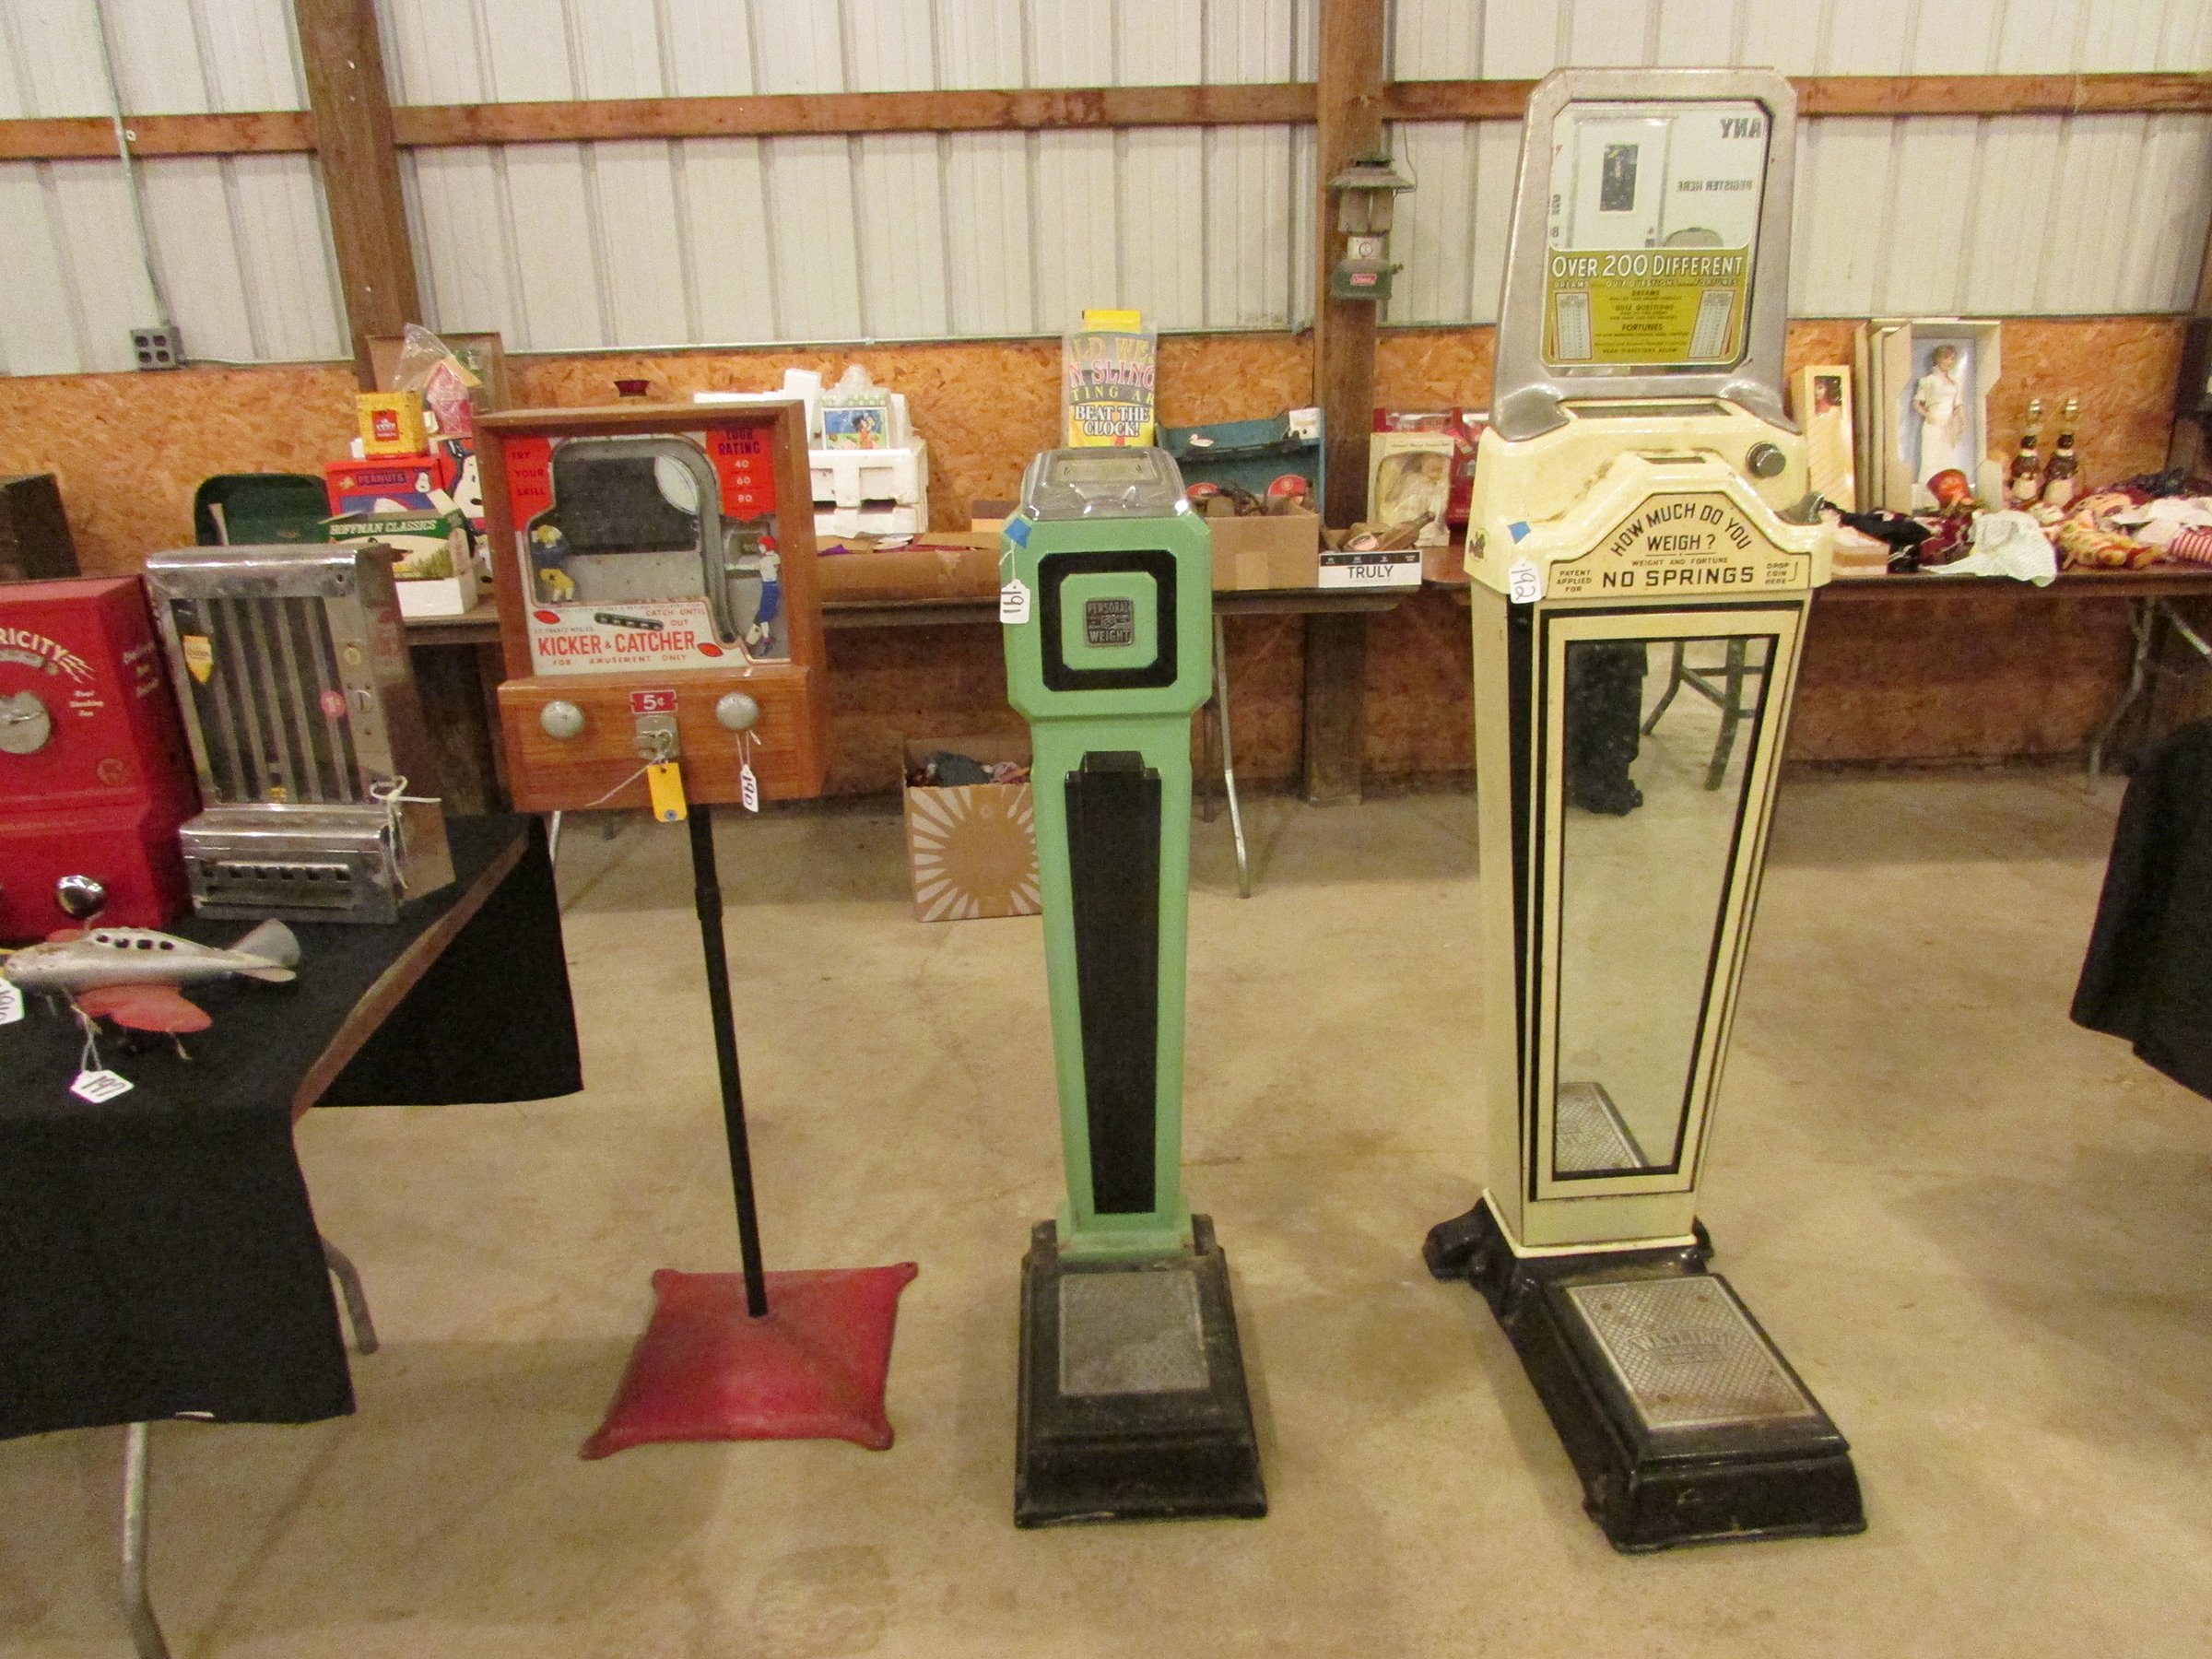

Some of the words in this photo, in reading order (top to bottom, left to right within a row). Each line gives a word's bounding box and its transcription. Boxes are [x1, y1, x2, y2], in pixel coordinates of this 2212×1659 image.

[1552, 256, 1597, 276] OVER
[1603, 254, 1648, 276] 200
[1653, 255, 1743, 276] DIFFERENT
[1622, 324, 1663, 332] FORTUNES
[1070, 336, 1104, 362] LD
[1114, 336, 1155, 362] WE
[1071, 385, 1118, 401] TING
[1076, 406, 1113, 421] BEAT
[1118, 406, 1150, 422] THE
[1084, 420, 1140, 437] CLOCK!
[512, 451, 530, 459] TRY
[718, 441, 760, 455] RATING
[735, 459, 749, 468] 40
[358, 473, 406, 486] PEANUTS
[514, 469, 545, 477] YOUR
[736, 477, 751, 485] 60
[516, 487, 546, 497] SKILL
[737, 494, 753, 502] 80
[330, 523, 382, 535] HOFFMAN
[385, 520, 437, 533] CLASSICS
[1610, 519, 1644, 556] HOW
[1646, 503, 1696, 527] MUCH
[1700, 505, 1724, 525] DO
[1724, 518, 1752, 550] YOU
[1647, 534, 1700, 551] WEIGH
[1690, 557, 1728, 565] FORTUNE
[1347, 565, 1394, 579] TRULY
[1603, 571, 1635, 588] NO
[1645, 567, 1754, 586] SPRINGS
[1511, 568, 1536, 600] 192
[680, 607, 707, 616] UNTIL
[537, 635, 602, 656] KICKER
[615, 630, 696, 653] CATCHER
[1089, 630, 1130, 642] WEIGHT
[589, 655, 651, 665] AMUSEMENT
[643, 694, 665, 711] 5¢
